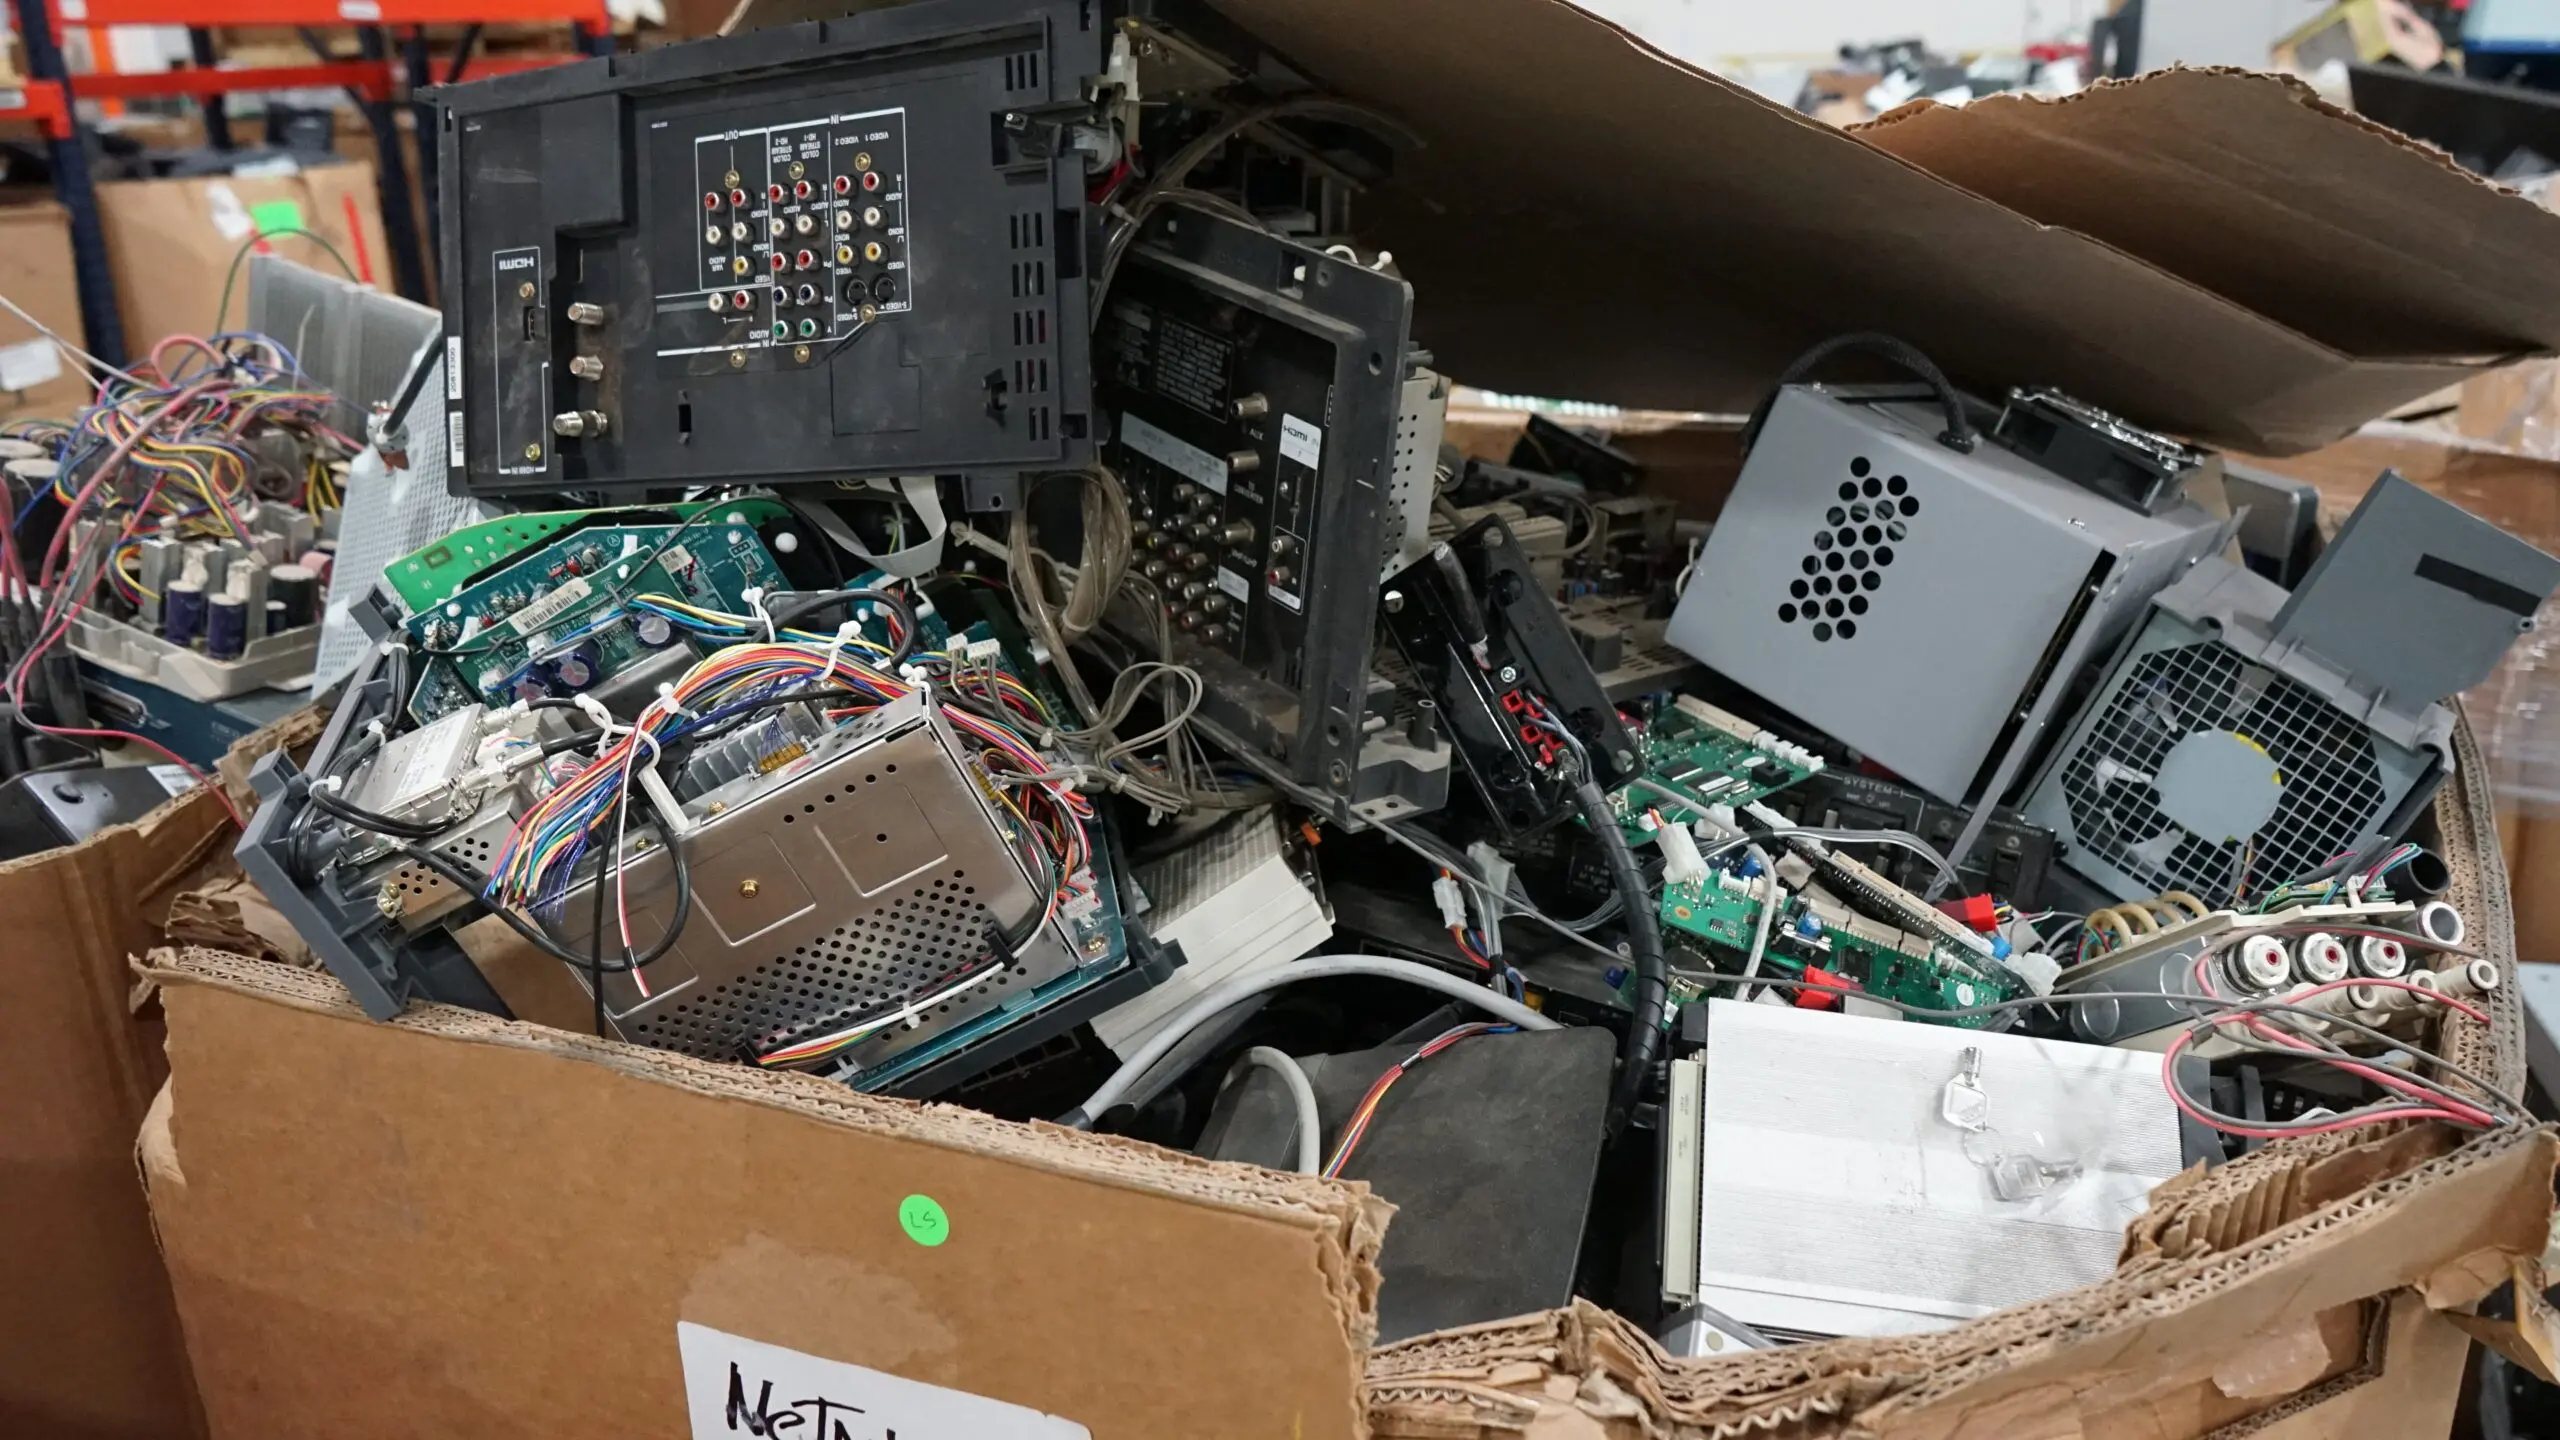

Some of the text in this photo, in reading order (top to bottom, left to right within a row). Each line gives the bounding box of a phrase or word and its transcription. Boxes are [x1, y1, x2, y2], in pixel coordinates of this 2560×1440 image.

[830, 114, 840, 125] IN
[724, 129, 739, 141] OUT
[870, 131, 889, 141] VIDEO
[840, 136, 859, 145] VIDEO
[771, 145, 792, 155] STREAM
[800, 141, 820, 151] STREAM
[773, 154, 791, 163] COLOR
[801, 149, 820, 159] COLOR
[885, 193, 902, 201] AUDIO
[811, 201, 829, 210] AUDIO
[833, 200, 849, 208] AUDIO
[751, 210, 768, 218] AUDIO
[783, 205, 801, 214] AUDIO
[888, 227, 904, 235] MONO
[752, 243, 769, 251] MONO
[499, 256, 535, 271] HDMI
[708, 256, 726, 265] AUDIO
[712, 264, 724, 272] VAR
[887, 261, 905, 270] VIDEO
[835, 267, 852, 275] VIDEO
[755, 274, 770, 283] VIDEO
[886, 301, 907, 310] S-VIDEO
[836, 313, 857, 321] S-VIDEO
[749, 329, 770, 339] AUDIO
[1249, 428, 1264, 441] AUX
[1283, 424, 1308, 442] HDMI
